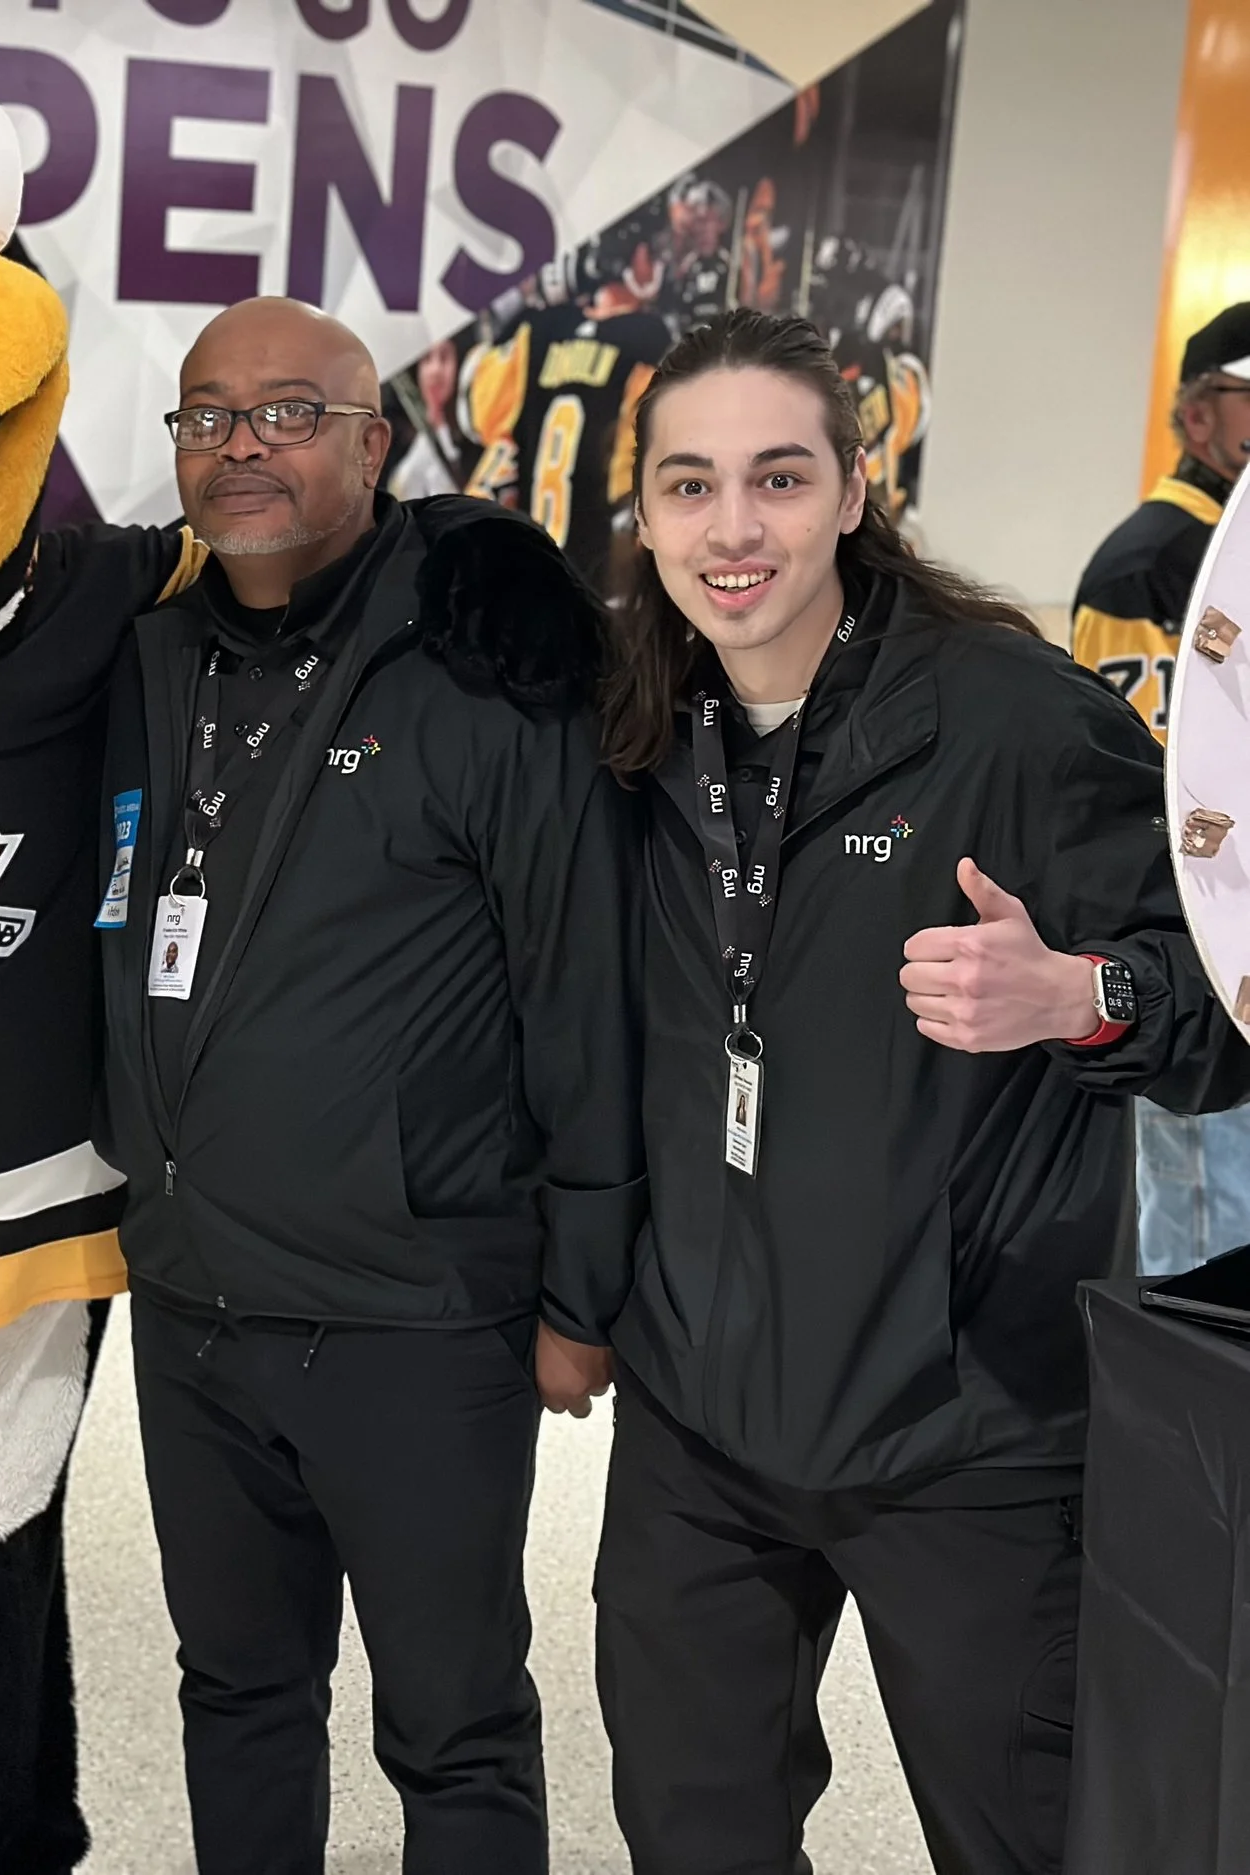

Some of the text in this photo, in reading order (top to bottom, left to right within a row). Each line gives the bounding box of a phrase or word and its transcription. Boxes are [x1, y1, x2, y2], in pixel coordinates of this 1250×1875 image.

[837, 615, 856, 643] nrg
[295, 655, 319, 680] nrg
[703, 699, 719, 727] nrg
[203, 723, 216, 749] nrg
[247, 722, 270, 748] nrg
[326, 748, 361, 774] nrg
[203, 791, 226, 817] nrg
[709, 783, 726, 813] nrg
[766, 777, 781, 807] nrg
[844, 833, 892, 862] nrg
[722, 868, 738, 898] nrg
[747, 865, 765, 895] nrg
[167, 914, 181, 925] nrg
[734, 952, 753, 978] nrg
